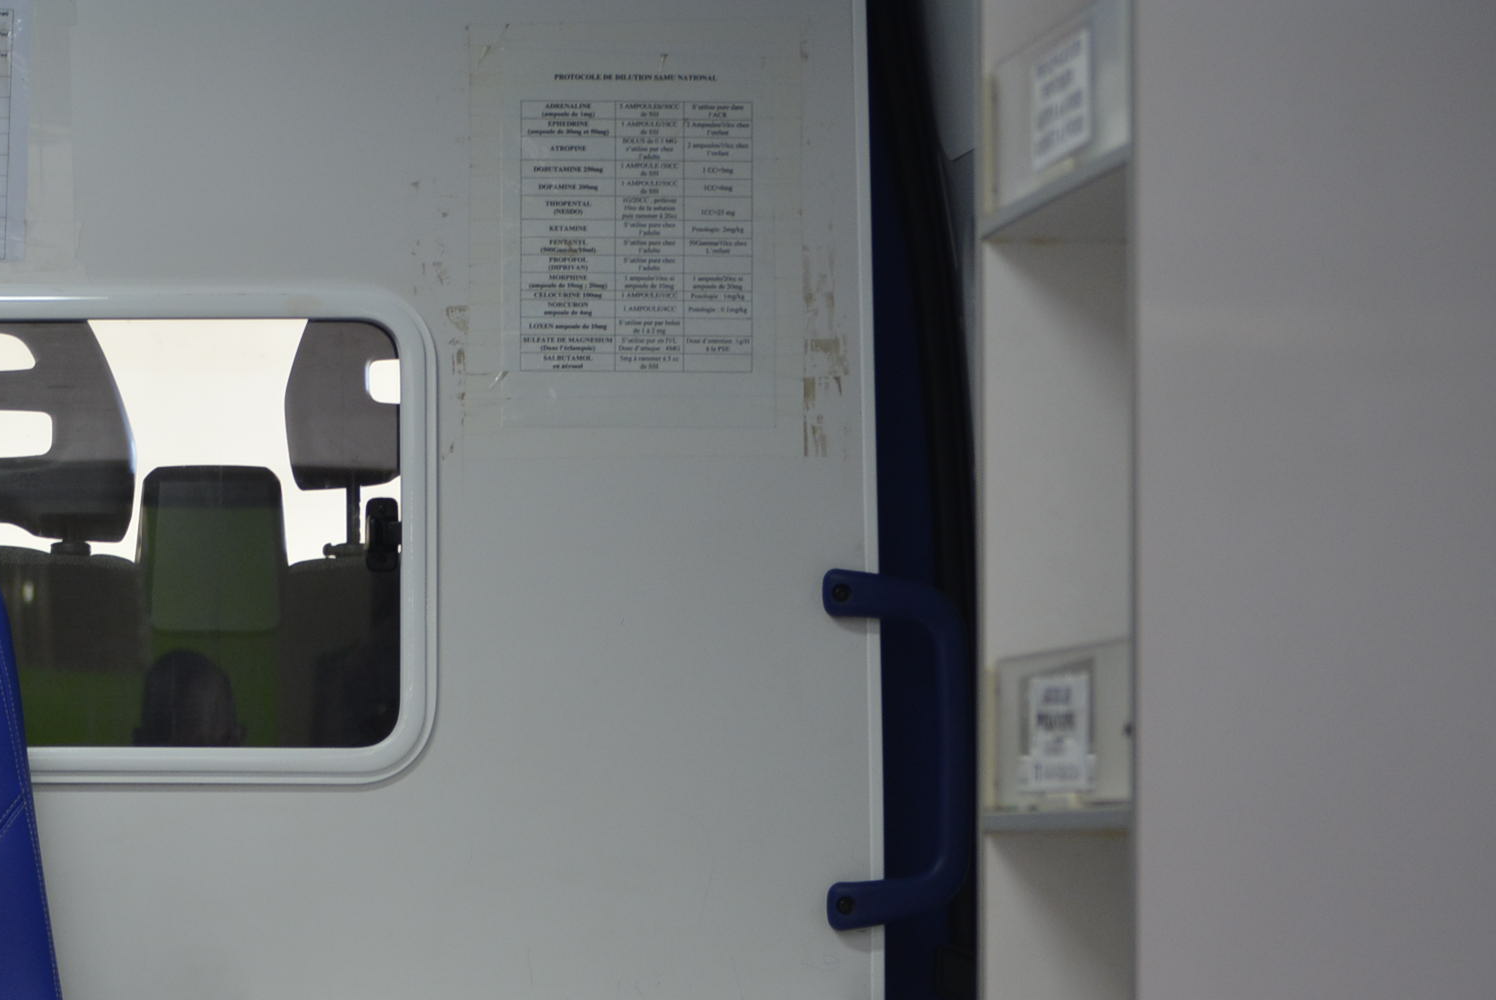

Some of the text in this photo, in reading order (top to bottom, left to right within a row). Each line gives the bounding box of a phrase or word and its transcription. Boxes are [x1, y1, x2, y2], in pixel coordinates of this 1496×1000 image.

[554, 73, 602, 81] PROTOCOLE
[603, 73, 612, 81] DE
[615, 73, 653, 81] DILUTION
[677, 73, 717, 81] NATIONAL
